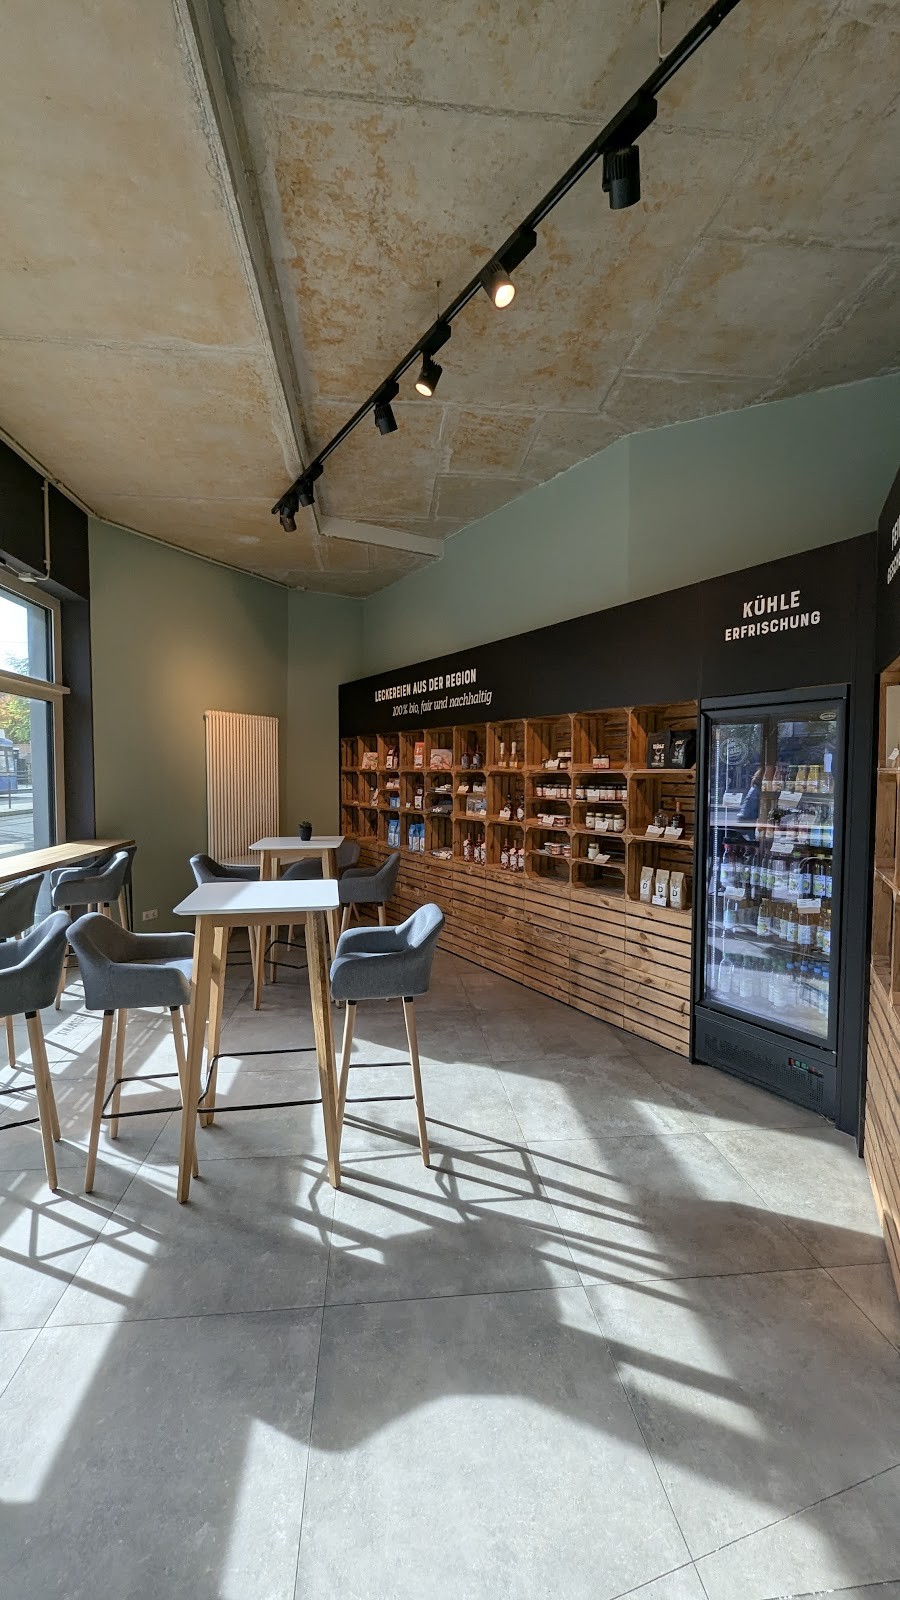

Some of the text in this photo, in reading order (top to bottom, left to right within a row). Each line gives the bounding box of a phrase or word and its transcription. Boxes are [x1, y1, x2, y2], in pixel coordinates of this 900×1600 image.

[742, 590, 800, 619] KÜHLE
[725, 610, 820, 641] ERFRISCHUNG
[374, 668, 477, 702] LECKEREIEN AUS DER REGION
[392, 689, 493, 716] 100% bio, fair und nachhaltig
